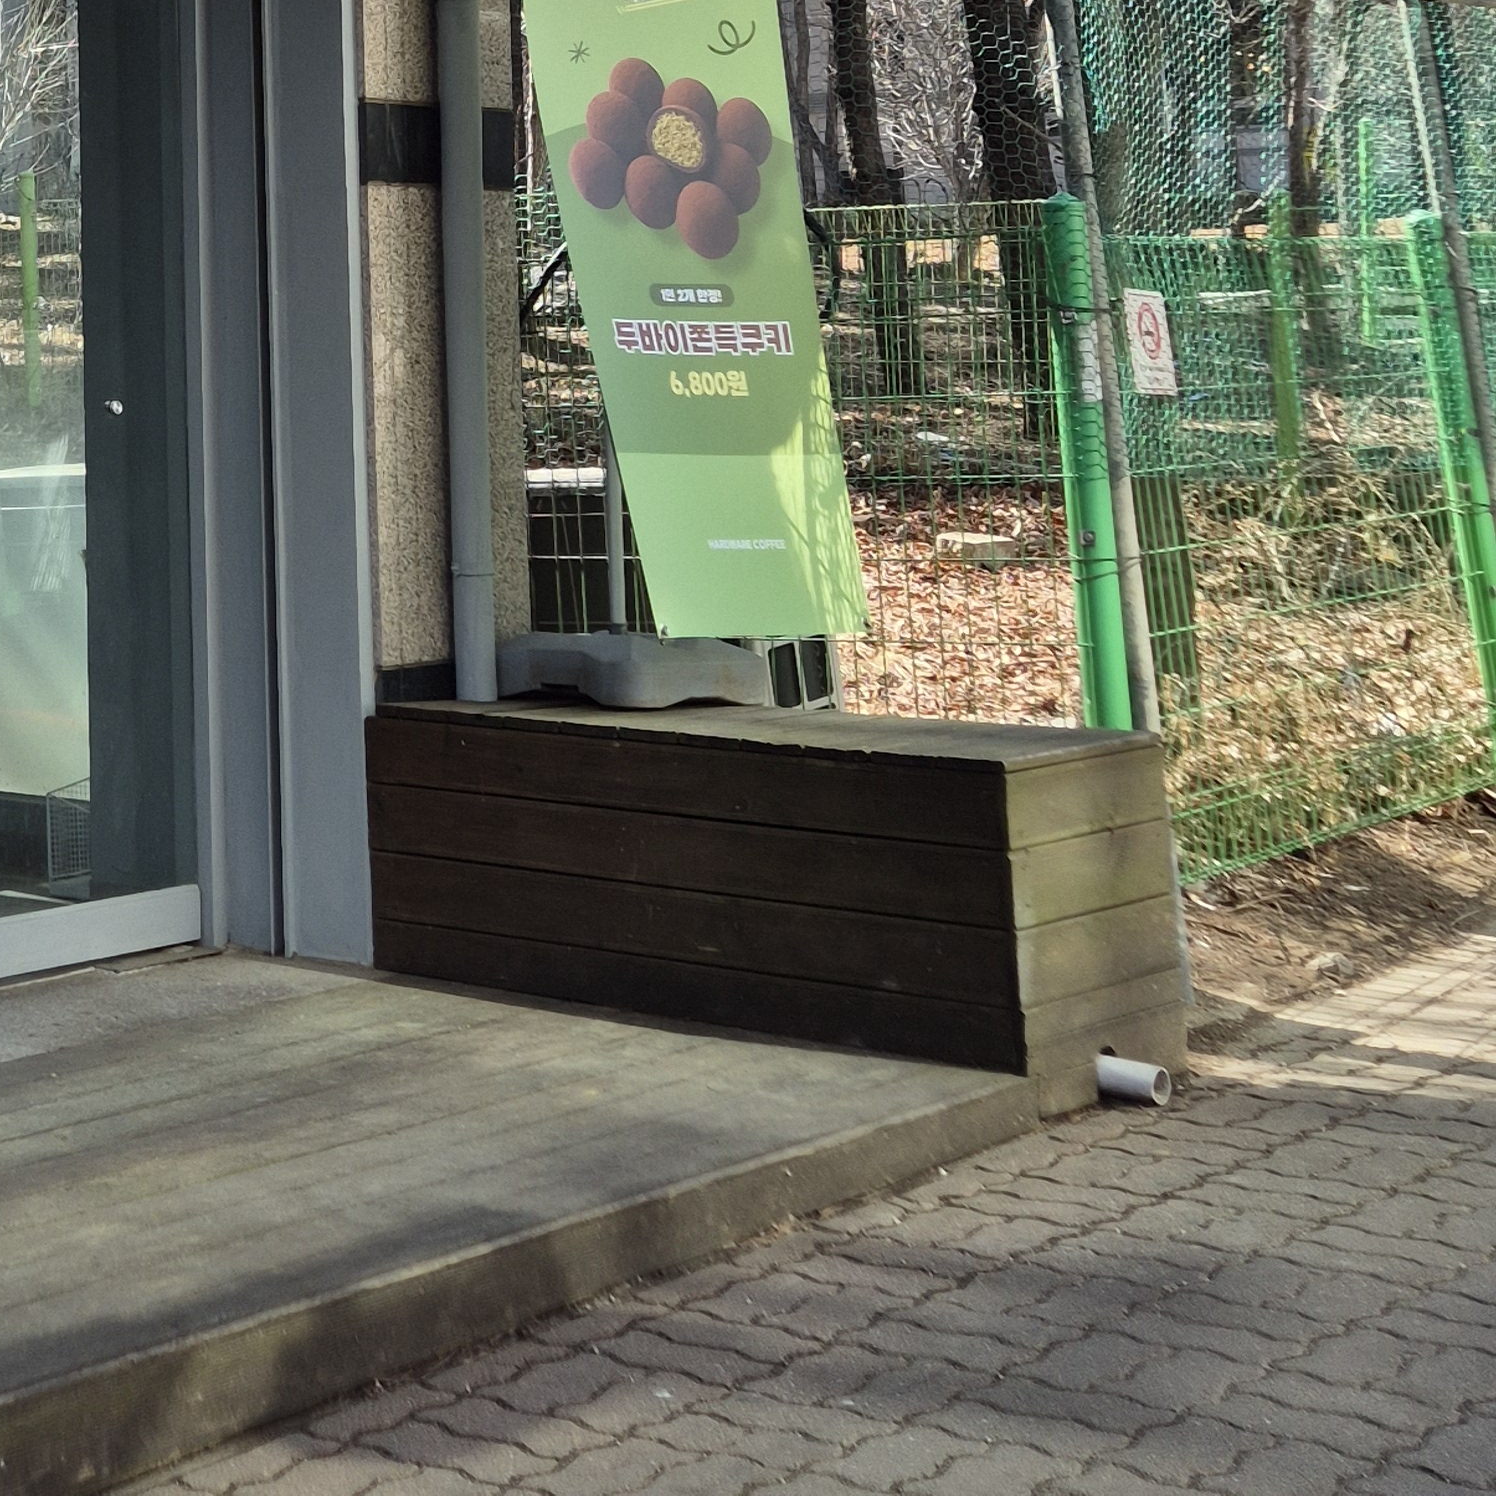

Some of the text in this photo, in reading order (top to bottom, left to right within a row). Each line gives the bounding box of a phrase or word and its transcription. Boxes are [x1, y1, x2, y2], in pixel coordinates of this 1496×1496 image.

[676, 288, 696, 303] 2개
[612, 318, 794, 356] 두바이쫀득쿠키
[669, 370, 750, 398] 6,800원
[707, 538, 786, 550] HARDWARE COFFEE
